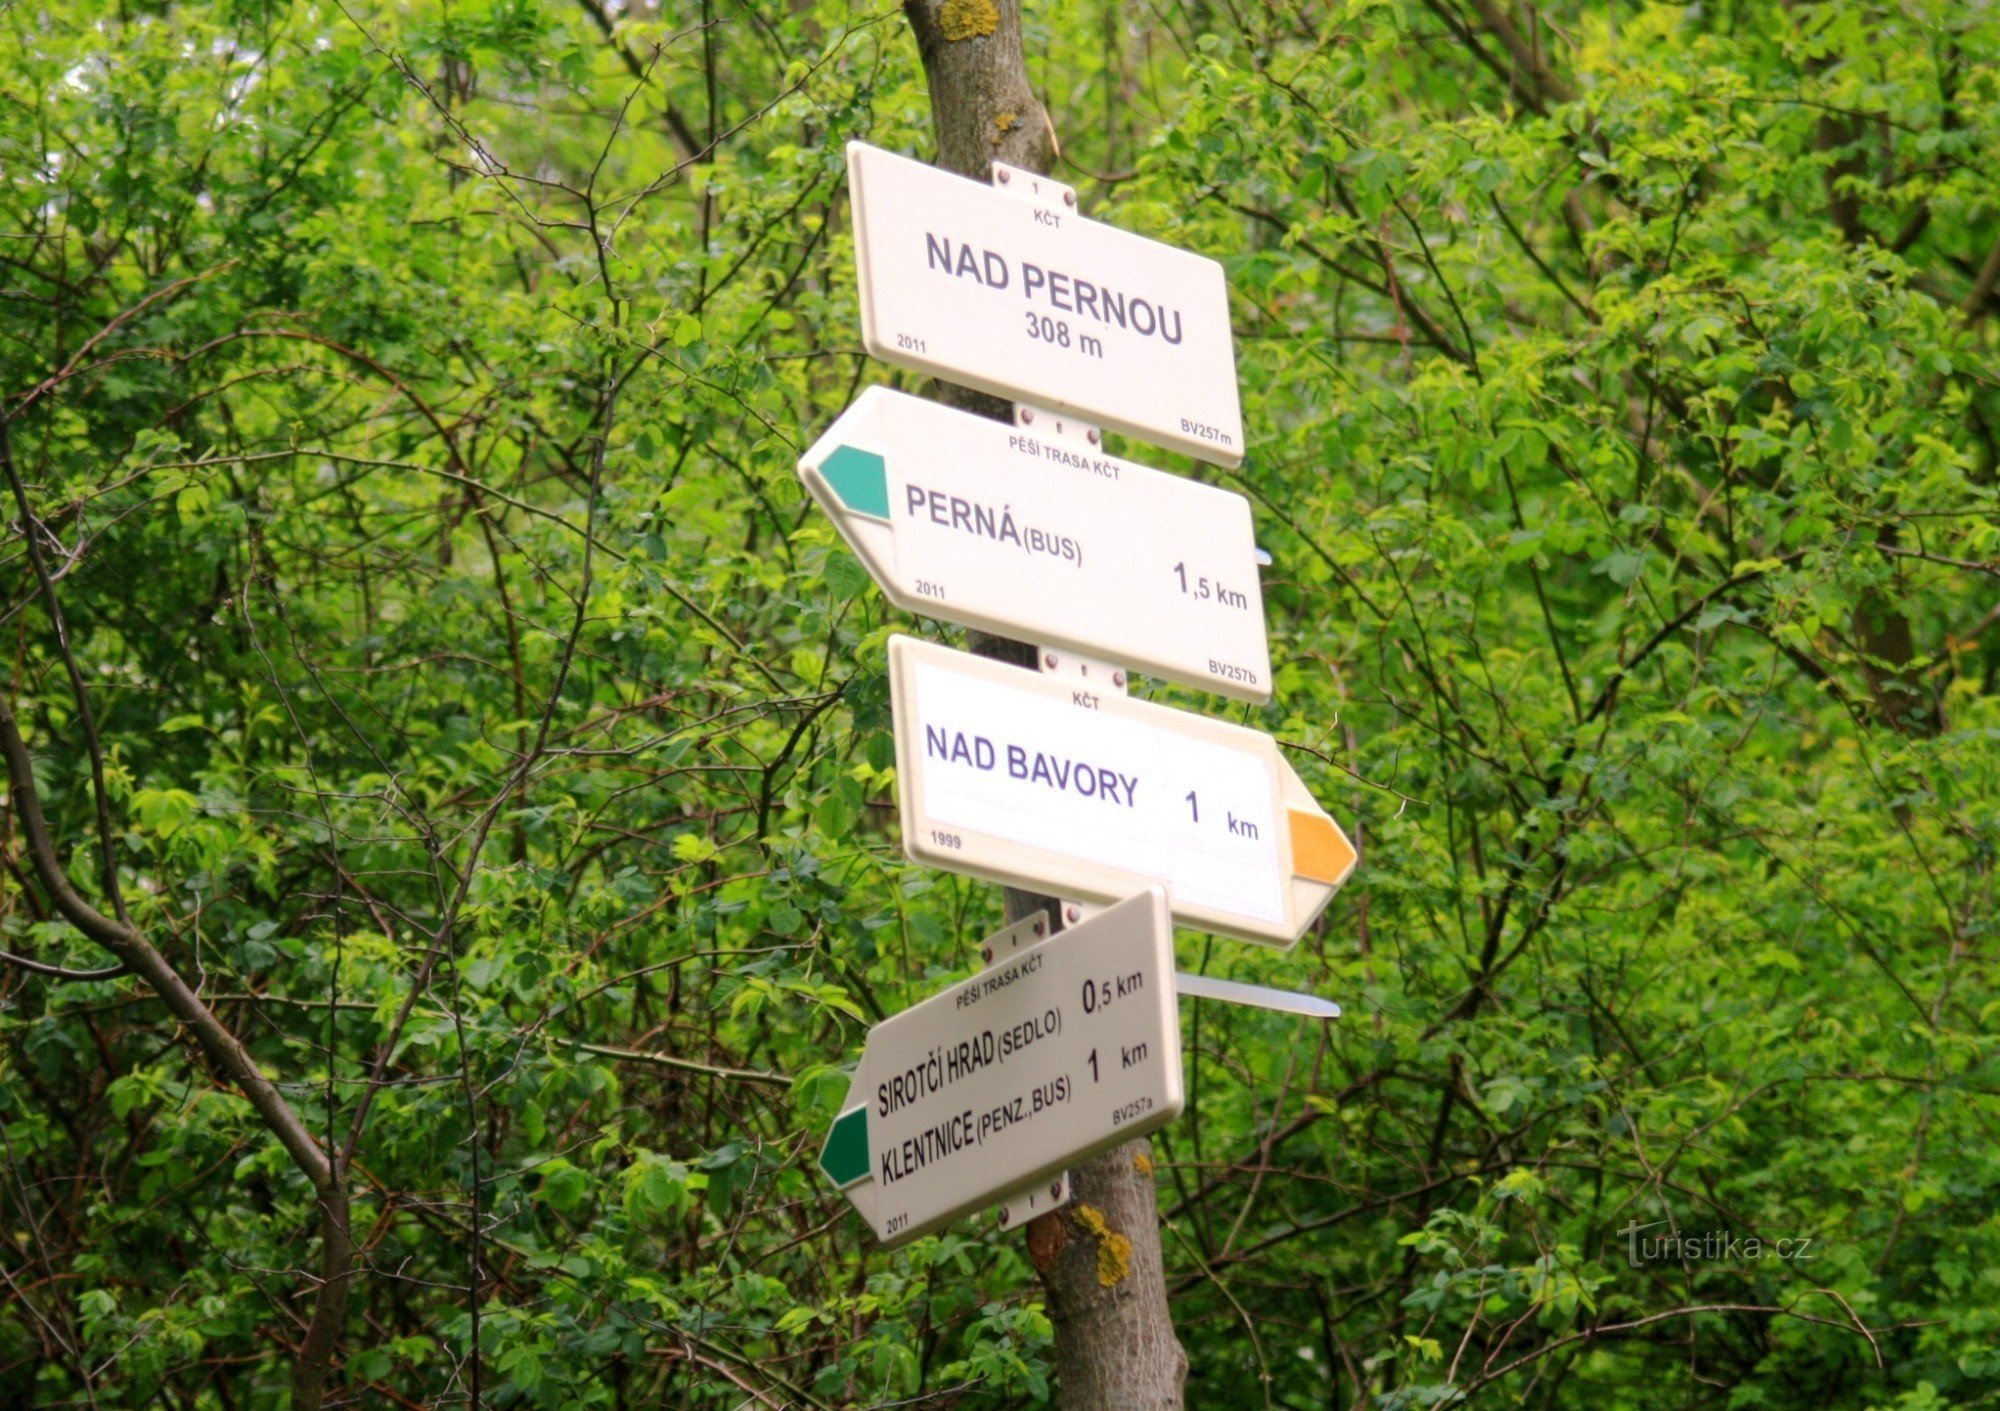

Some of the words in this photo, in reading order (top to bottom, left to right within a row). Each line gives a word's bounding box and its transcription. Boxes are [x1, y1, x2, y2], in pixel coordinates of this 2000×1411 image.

[1034, 209, 1060, 229] KČT
[926, 232, 1009, 290] NAD
[1022, 262, 1183, 345] PERNOU
[897, 333, 926, 354] 2011
[1025, 312, 1071, 348] 308
[1081, 335, 1103, 358] m
[1181, 418, 1232, 445] BV257m
[1009, 435, 1040, 457] PĚŠÍ
[1044, 447, 1090, 472] TRASA
[1093, 460, 1120, 480] KČT
[915, 580, 945, 599] 2011
[1217, 582, 1248, 610] km
[1208, 659, 1257, 685] BV257b
[1072, 691, 1099, 710] KČT
[926, 724, 995, 770] NAD
[1007, 745, 1138, 808] BAVORY
[1185, 791, 1199, 823] 1
[1227, 812, 1259, 841] km
[930, 830, 962, 850] 1999
[956, 987, 981, 1010] PĚŠÍ
[982, 971, 1020, 997] TRASA
[1021, 954, 1044, 981] KČT
[877, 1046, 944, 1118] SIROTČÍ
[1116, 969, 1143, 1000] km
[1087, 1048, 1099, 1083] 1
[1121, 1041, 1148, 1070] km
[886, 1213, 909, 1235] 2011
